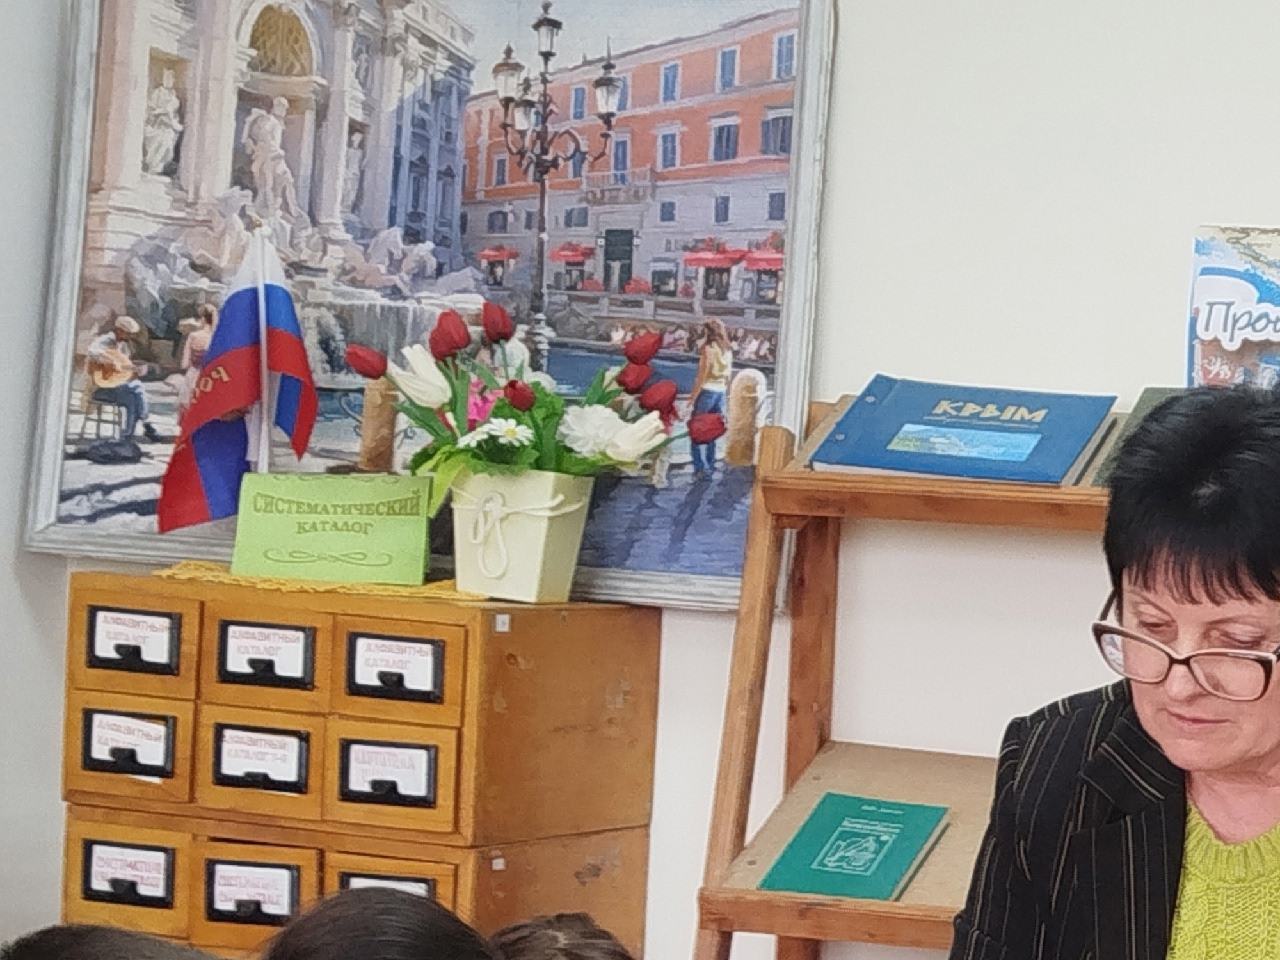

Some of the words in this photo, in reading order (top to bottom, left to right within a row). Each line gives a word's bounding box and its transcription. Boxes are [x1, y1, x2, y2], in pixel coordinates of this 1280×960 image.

[931, 400, 1049, 422] КРЫМ
[252, 490, 422, 517] СИСТЕМАТИЧЕСКИЙ
[296, 521, 373, 535] КАТАЛОГ
